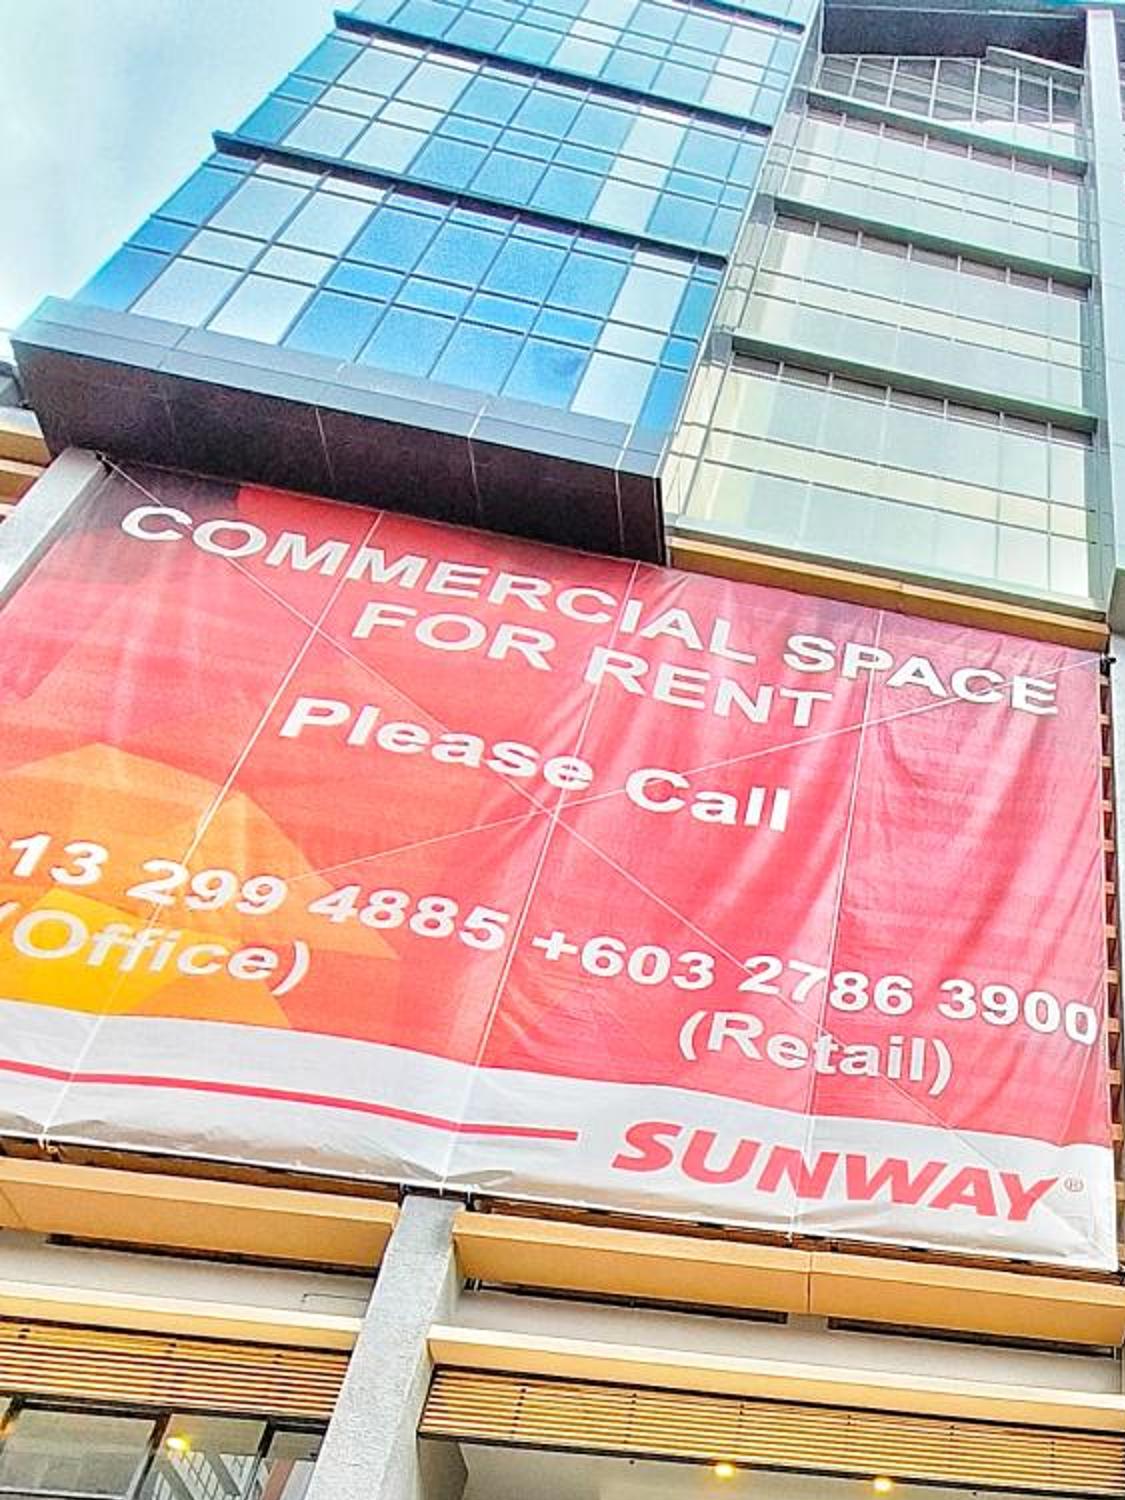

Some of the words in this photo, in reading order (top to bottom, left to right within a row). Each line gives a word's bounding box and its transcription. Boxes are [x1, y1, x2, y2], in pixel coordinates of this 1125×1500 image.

[121, 504, 757, 665] COMMERCIAL
[783, 633, 1059, 717] SPACE
[351, 601, 557, 672] FOR
[584, 646, 832, 729] RENT
[280, 697, 593, 791] Please
[625, 768, 791, 832] Call
[127, 859, 288, 915] 299
[308, 884, 512, 952] 4885
[532, 930, 715, 990] +603
[738, 955, 915, 1017] 2786
[938, 978, 1099, 1046] 3900
[677, 1009, 954, 1096] (Retail)
[611, 1120, 1059, 1222] SUNWAY
